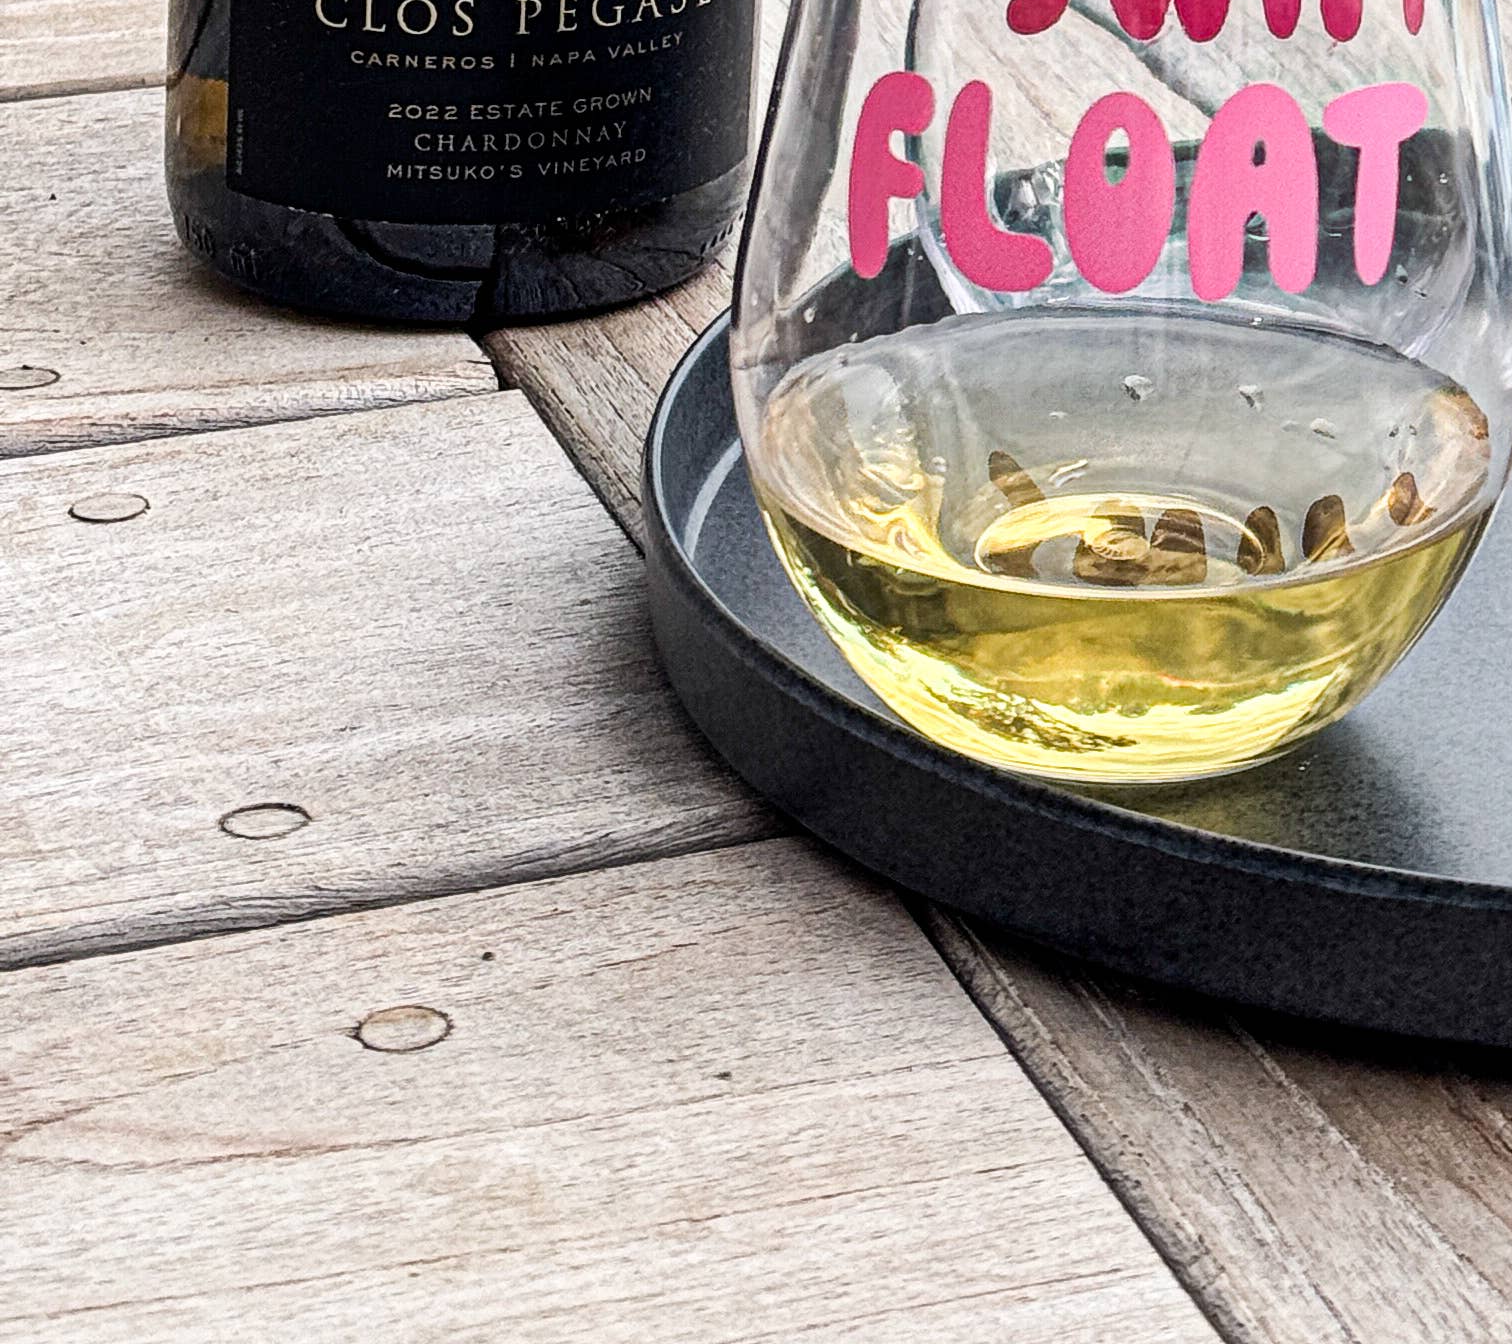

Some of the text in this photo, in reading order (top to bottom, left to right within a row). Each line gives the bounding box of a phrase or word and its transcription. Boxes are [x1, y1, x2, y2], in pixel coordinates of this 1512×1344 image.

[350, 31, 684, 70] CARNEROS NAPA VALLEY
[388, 87, 653, 120] 2022 ESTATE GROWN
[414, 120, 627, 153] CHARDONNAY
[387, 148, 647, 181] MITSUKO'S VINEYARD
[848, 71, 1429, 302] FLOAT
